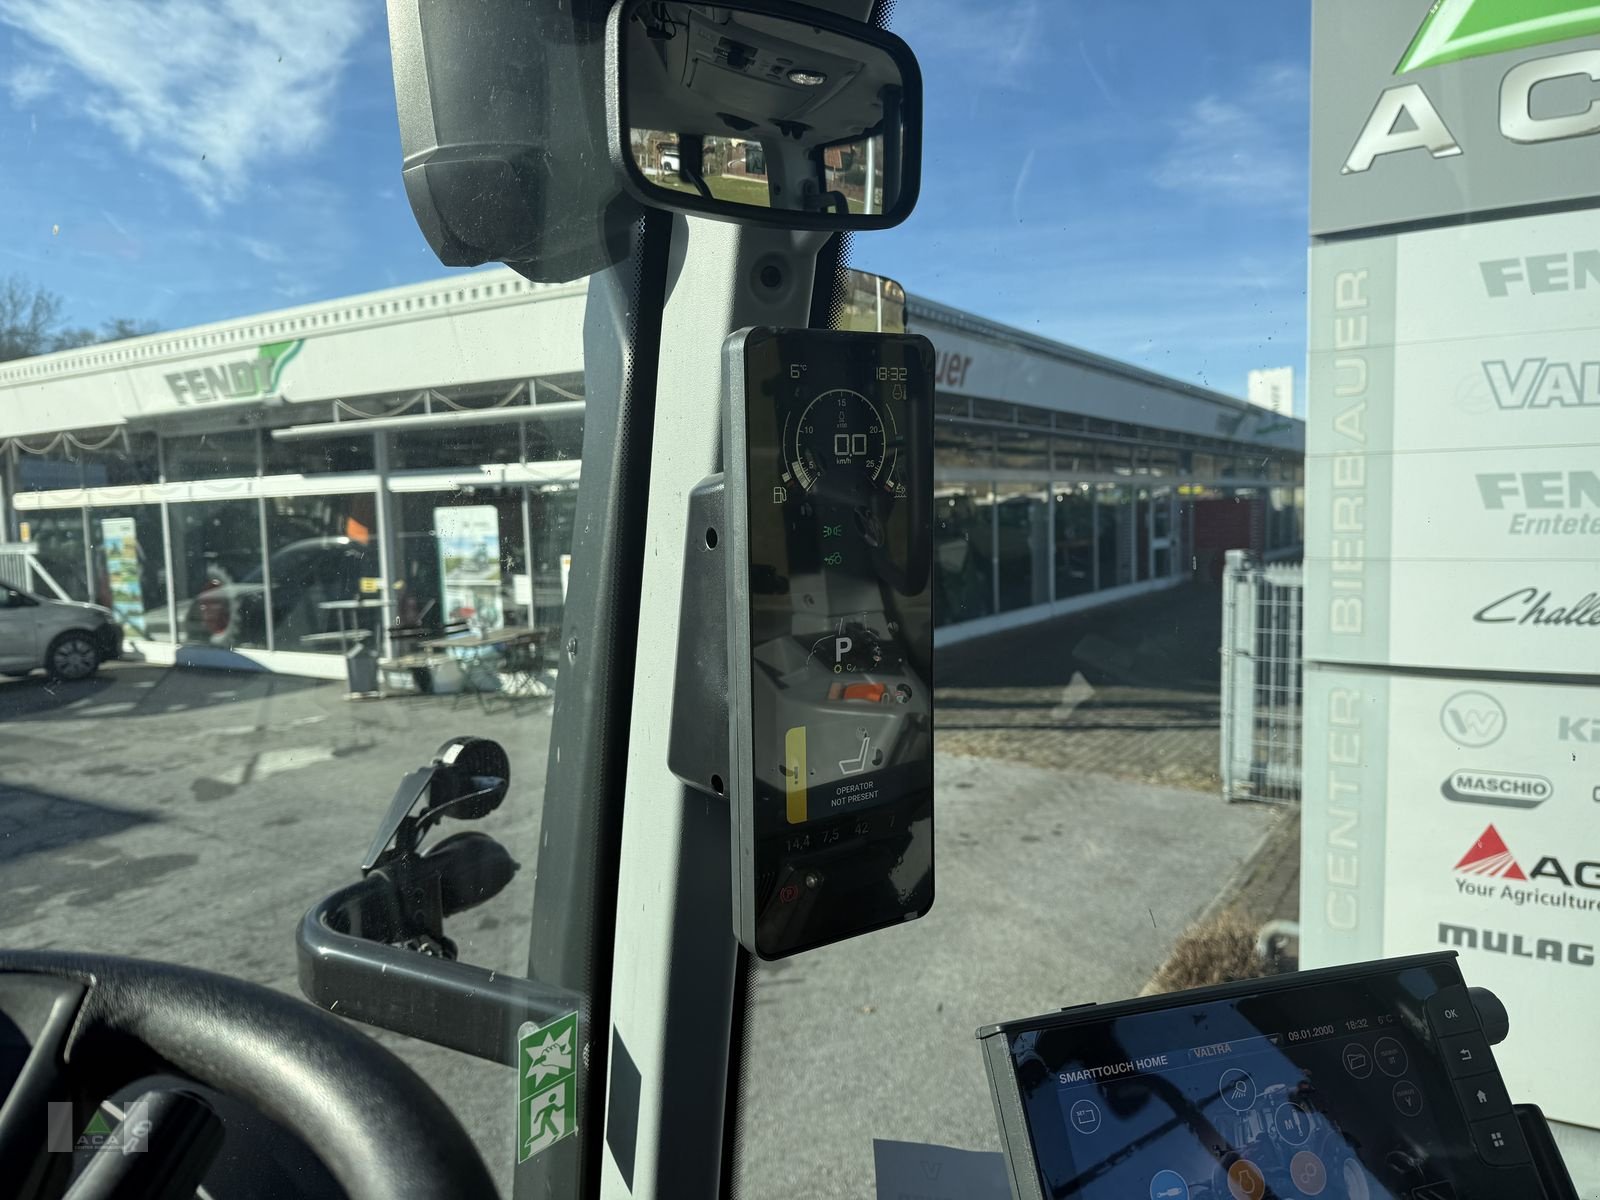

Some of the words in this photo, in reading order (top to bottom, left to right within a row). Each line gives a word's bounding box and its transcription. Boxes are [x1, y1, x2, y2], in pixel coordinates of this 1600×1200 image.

[1341, 50, 1600, 176] AC
[164, 357, 274, 407] FENDT
[876, 367, 908, 381] 18:32
[804, 426, 814, 434] 10
[869, 426, 879, 434] 20
[1332, 267, 1369, 635] BIERBAUER
[835, 637, 852, 663] P
[836, 781, 874, 795] OPERATOR
[1456, 775, 1547, 796] MASCHIO
[831, 797, 846, 807] NOT
[847, 790, 879, 804] PRESENT
[1326, 687, 1361, 931] CENTER
[1455, 877, 1495, 898] Your
[1444, 1009, 1458, 1019] OK
[1288, 1025, 1334, 1041] 09.01.2000
[1345, 1018, 1369, 1031] 18:32
[1194, 1043, 1232, 1058] VALTRA
[1059, 1061, 1134, 1084] SMARTTOUCH
[1136, 1055, 1168, 1070] HOME
